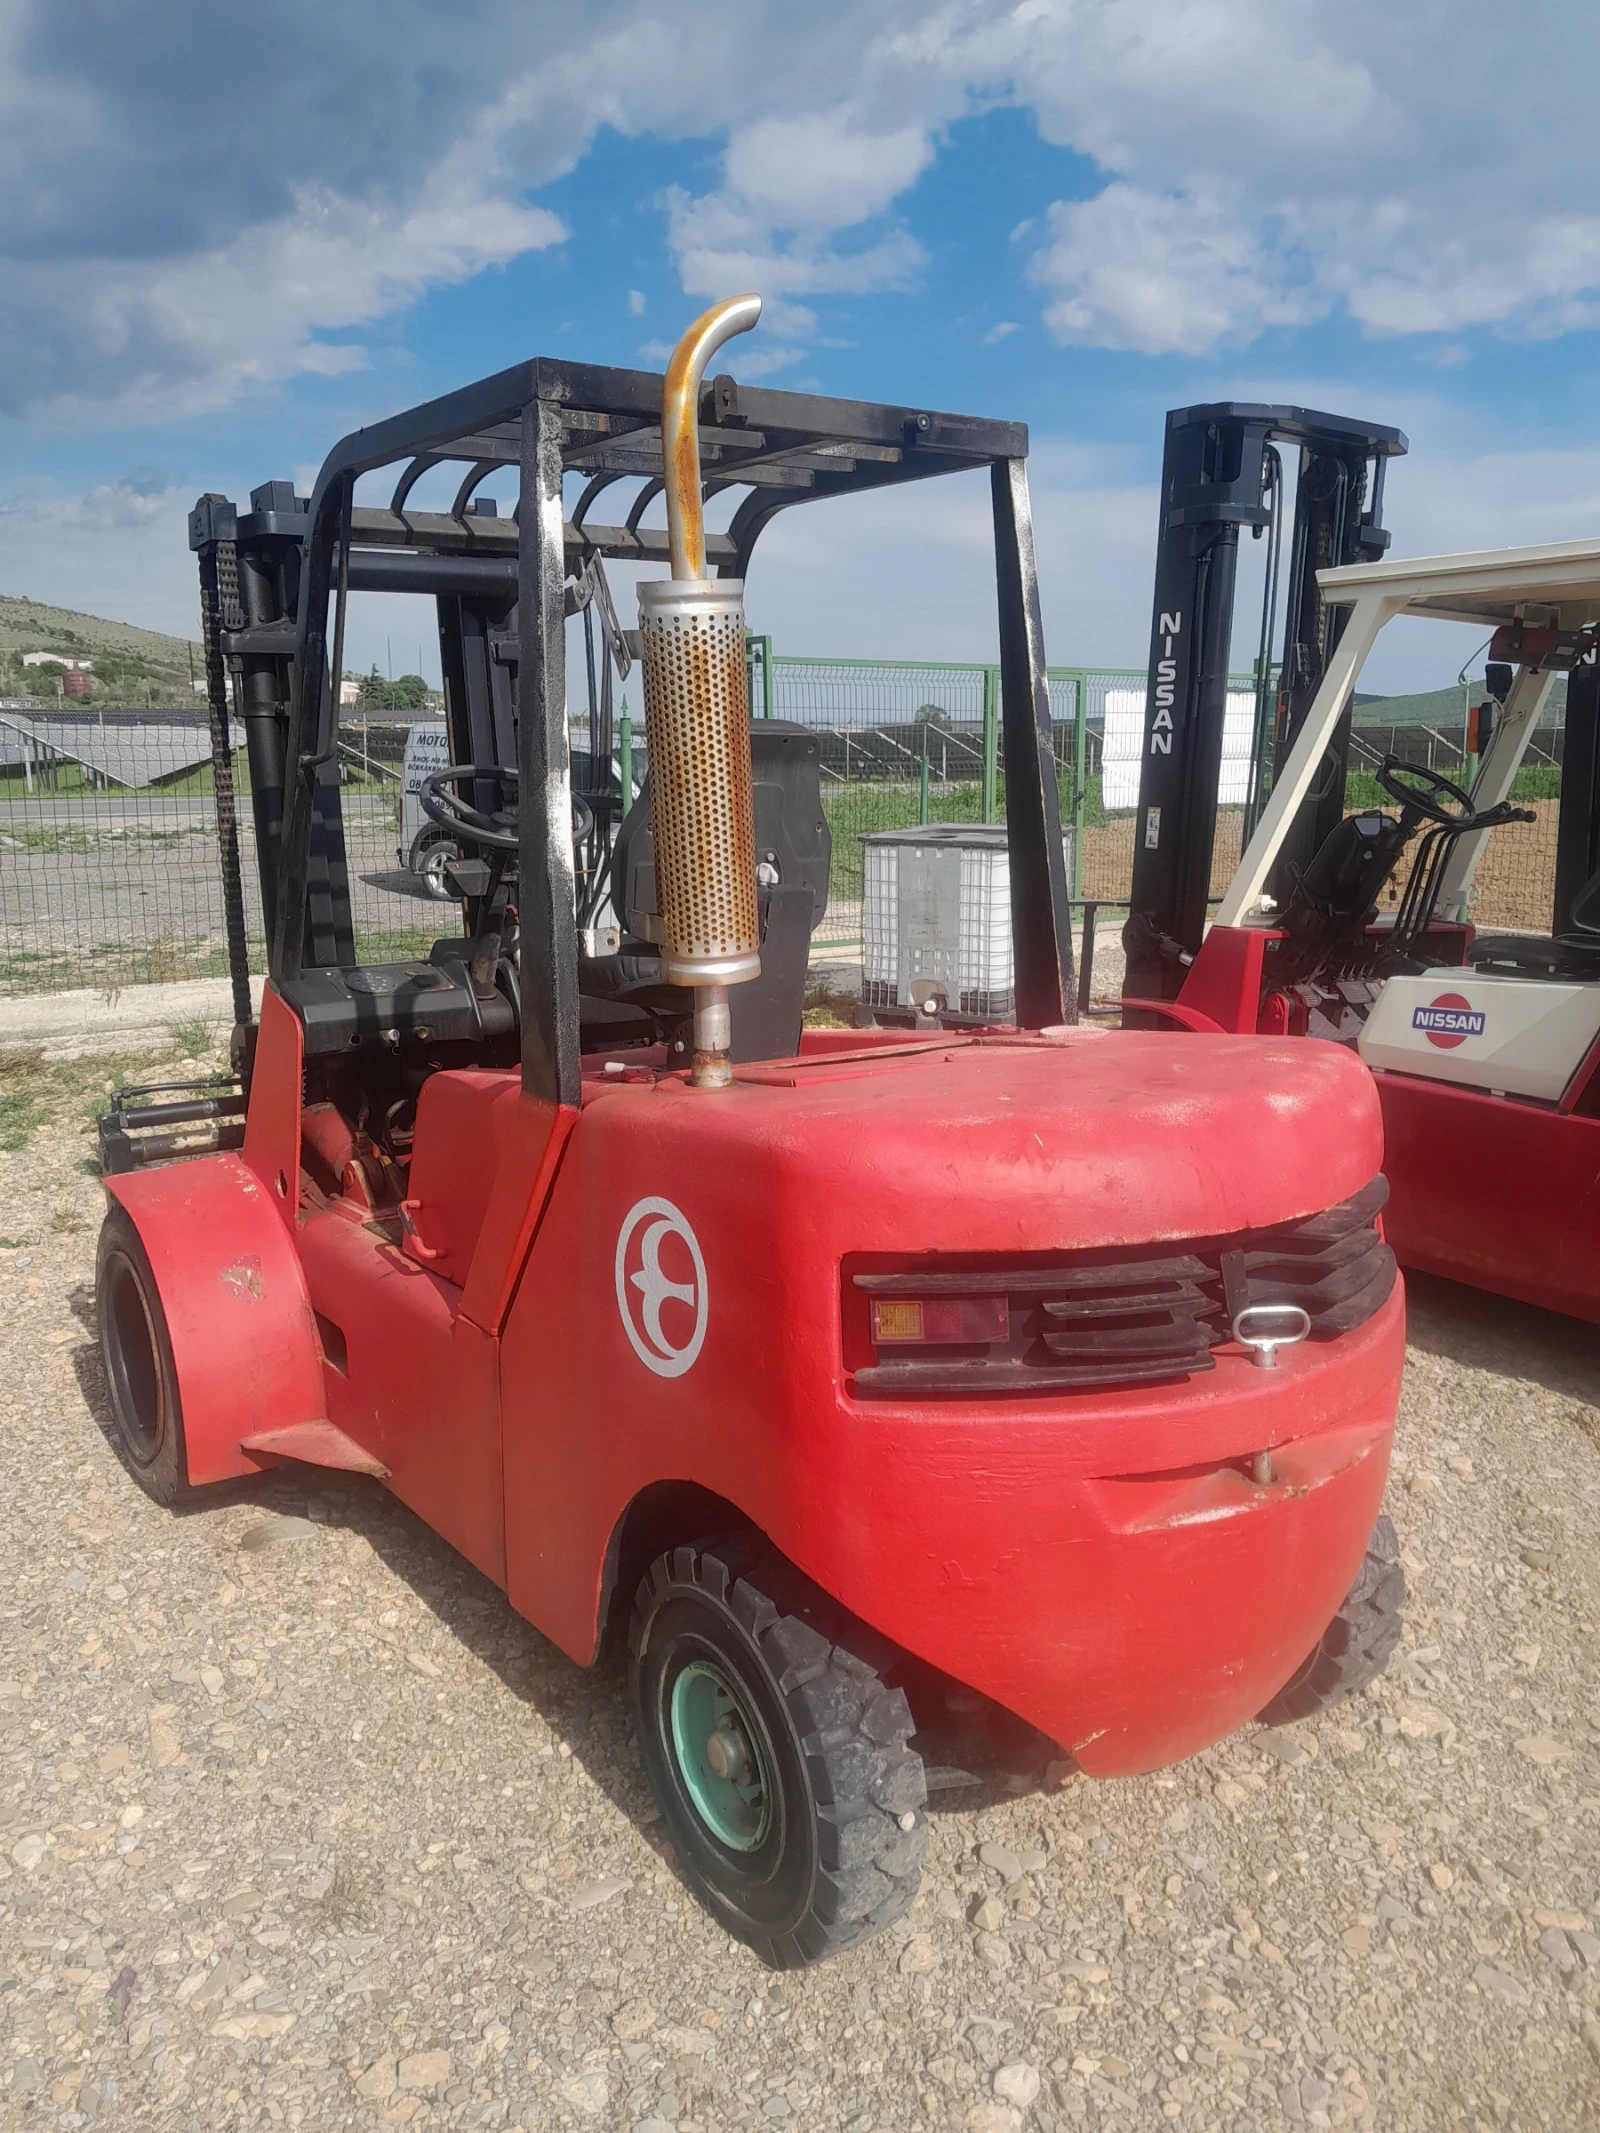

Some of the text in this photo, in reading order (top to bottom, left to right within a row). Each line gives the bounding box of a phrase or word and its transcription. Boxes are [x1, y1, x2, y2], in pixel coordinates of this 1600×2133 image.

[1151, 611, 1181, 755] NISSAN
[417, 735, 449, 747] МОТО
[1415, 1011, 1482, 1031] NISSAN
